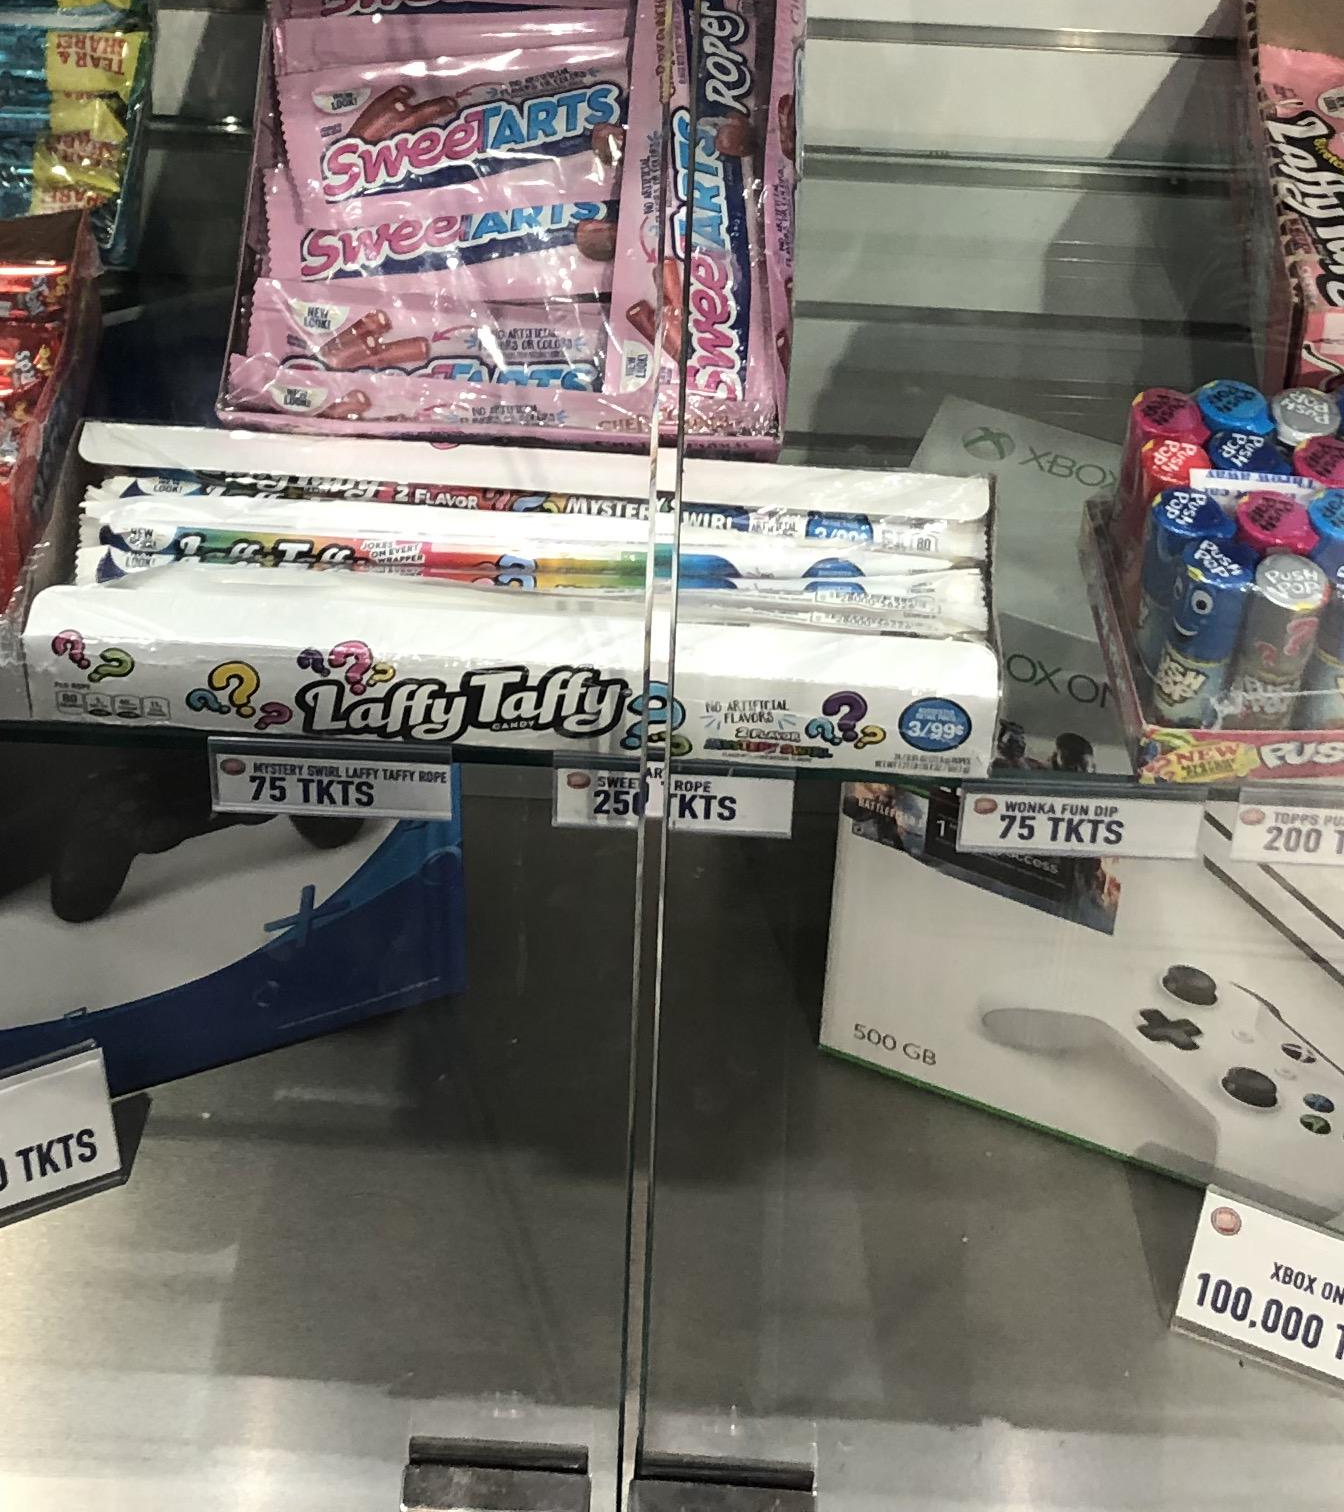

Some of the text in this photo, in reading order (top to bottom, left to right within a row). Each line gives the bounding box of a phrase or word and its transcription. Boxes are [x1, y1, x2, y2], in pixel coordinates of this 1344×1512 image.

[296, 665, 630, 742] Laffy Taffy
[705, 699, 790, 714] NO ARTIFICIAL
[723, 712, 775, 725] FLAVORS
[908, 720, 965, 740] 3/99¢
[253, 762, 447, 785] MYSTERY SWIRL LAFFY TAFFY ROPE
[250, 776, 375, 808] 75 TKTS
[1005, 800, 1119, 818] WONKA FUN DIP
[1273, 812, 1318, 826] TOPPS
[998, 814, 1124, 845] 75 TKTS
[1263, 826, 1323, 854] 200
[854, 1022, 938, 1068] 500 GB
[16, 1128, 99, 1183] TKTS
[1270, 1261, 1318, 1297] XBOX
[1195, 1271, 1324, 1351] 100,000
